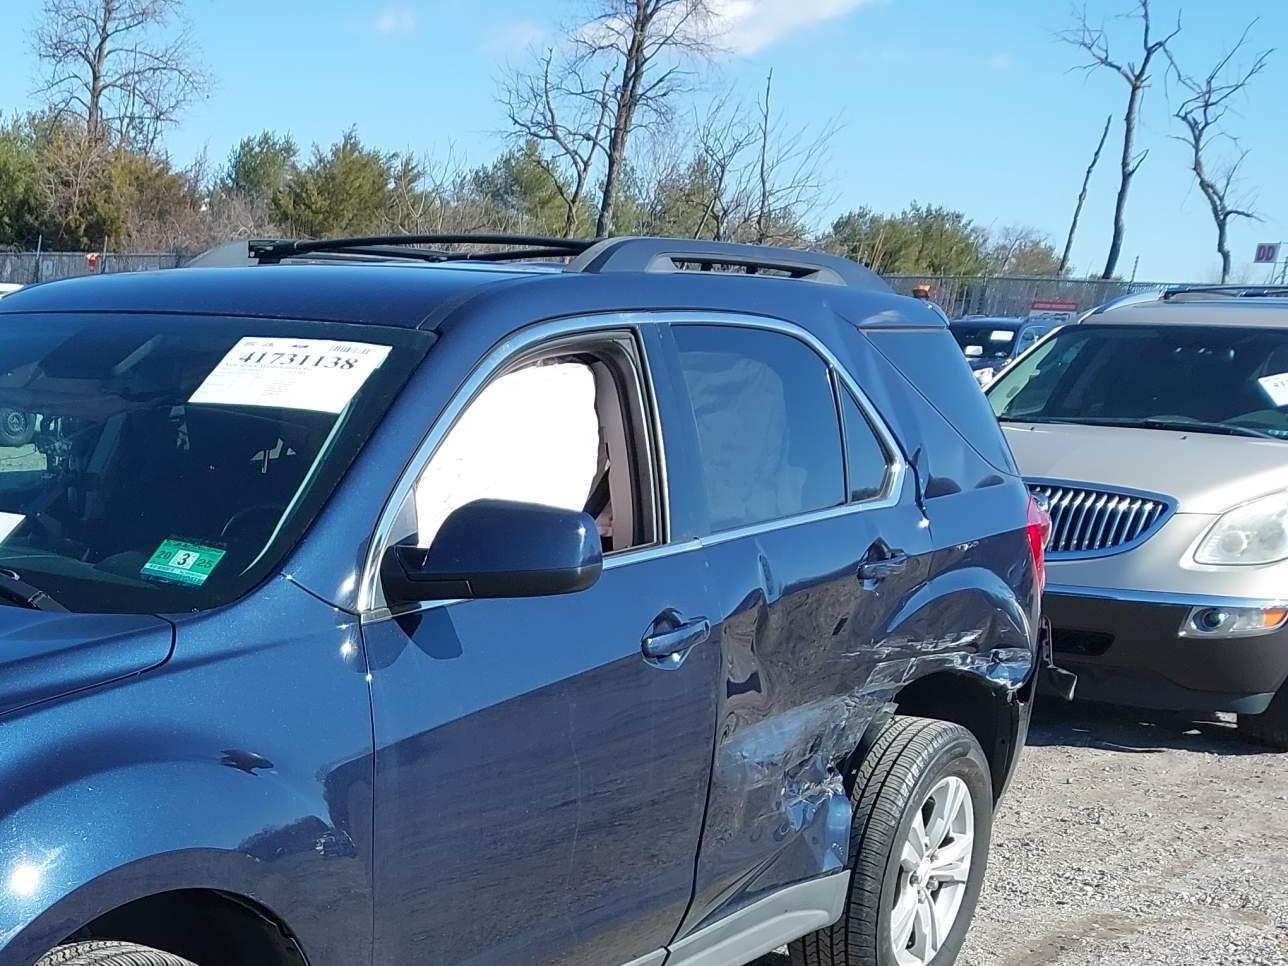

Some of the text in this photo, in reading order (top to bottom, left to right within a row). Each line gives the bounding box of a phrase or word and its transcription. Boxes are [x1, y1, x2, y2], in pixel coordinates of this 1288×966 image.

[239, 351, 359, 370] 41731138
[155, 550, 214, 569] 20 3 25
